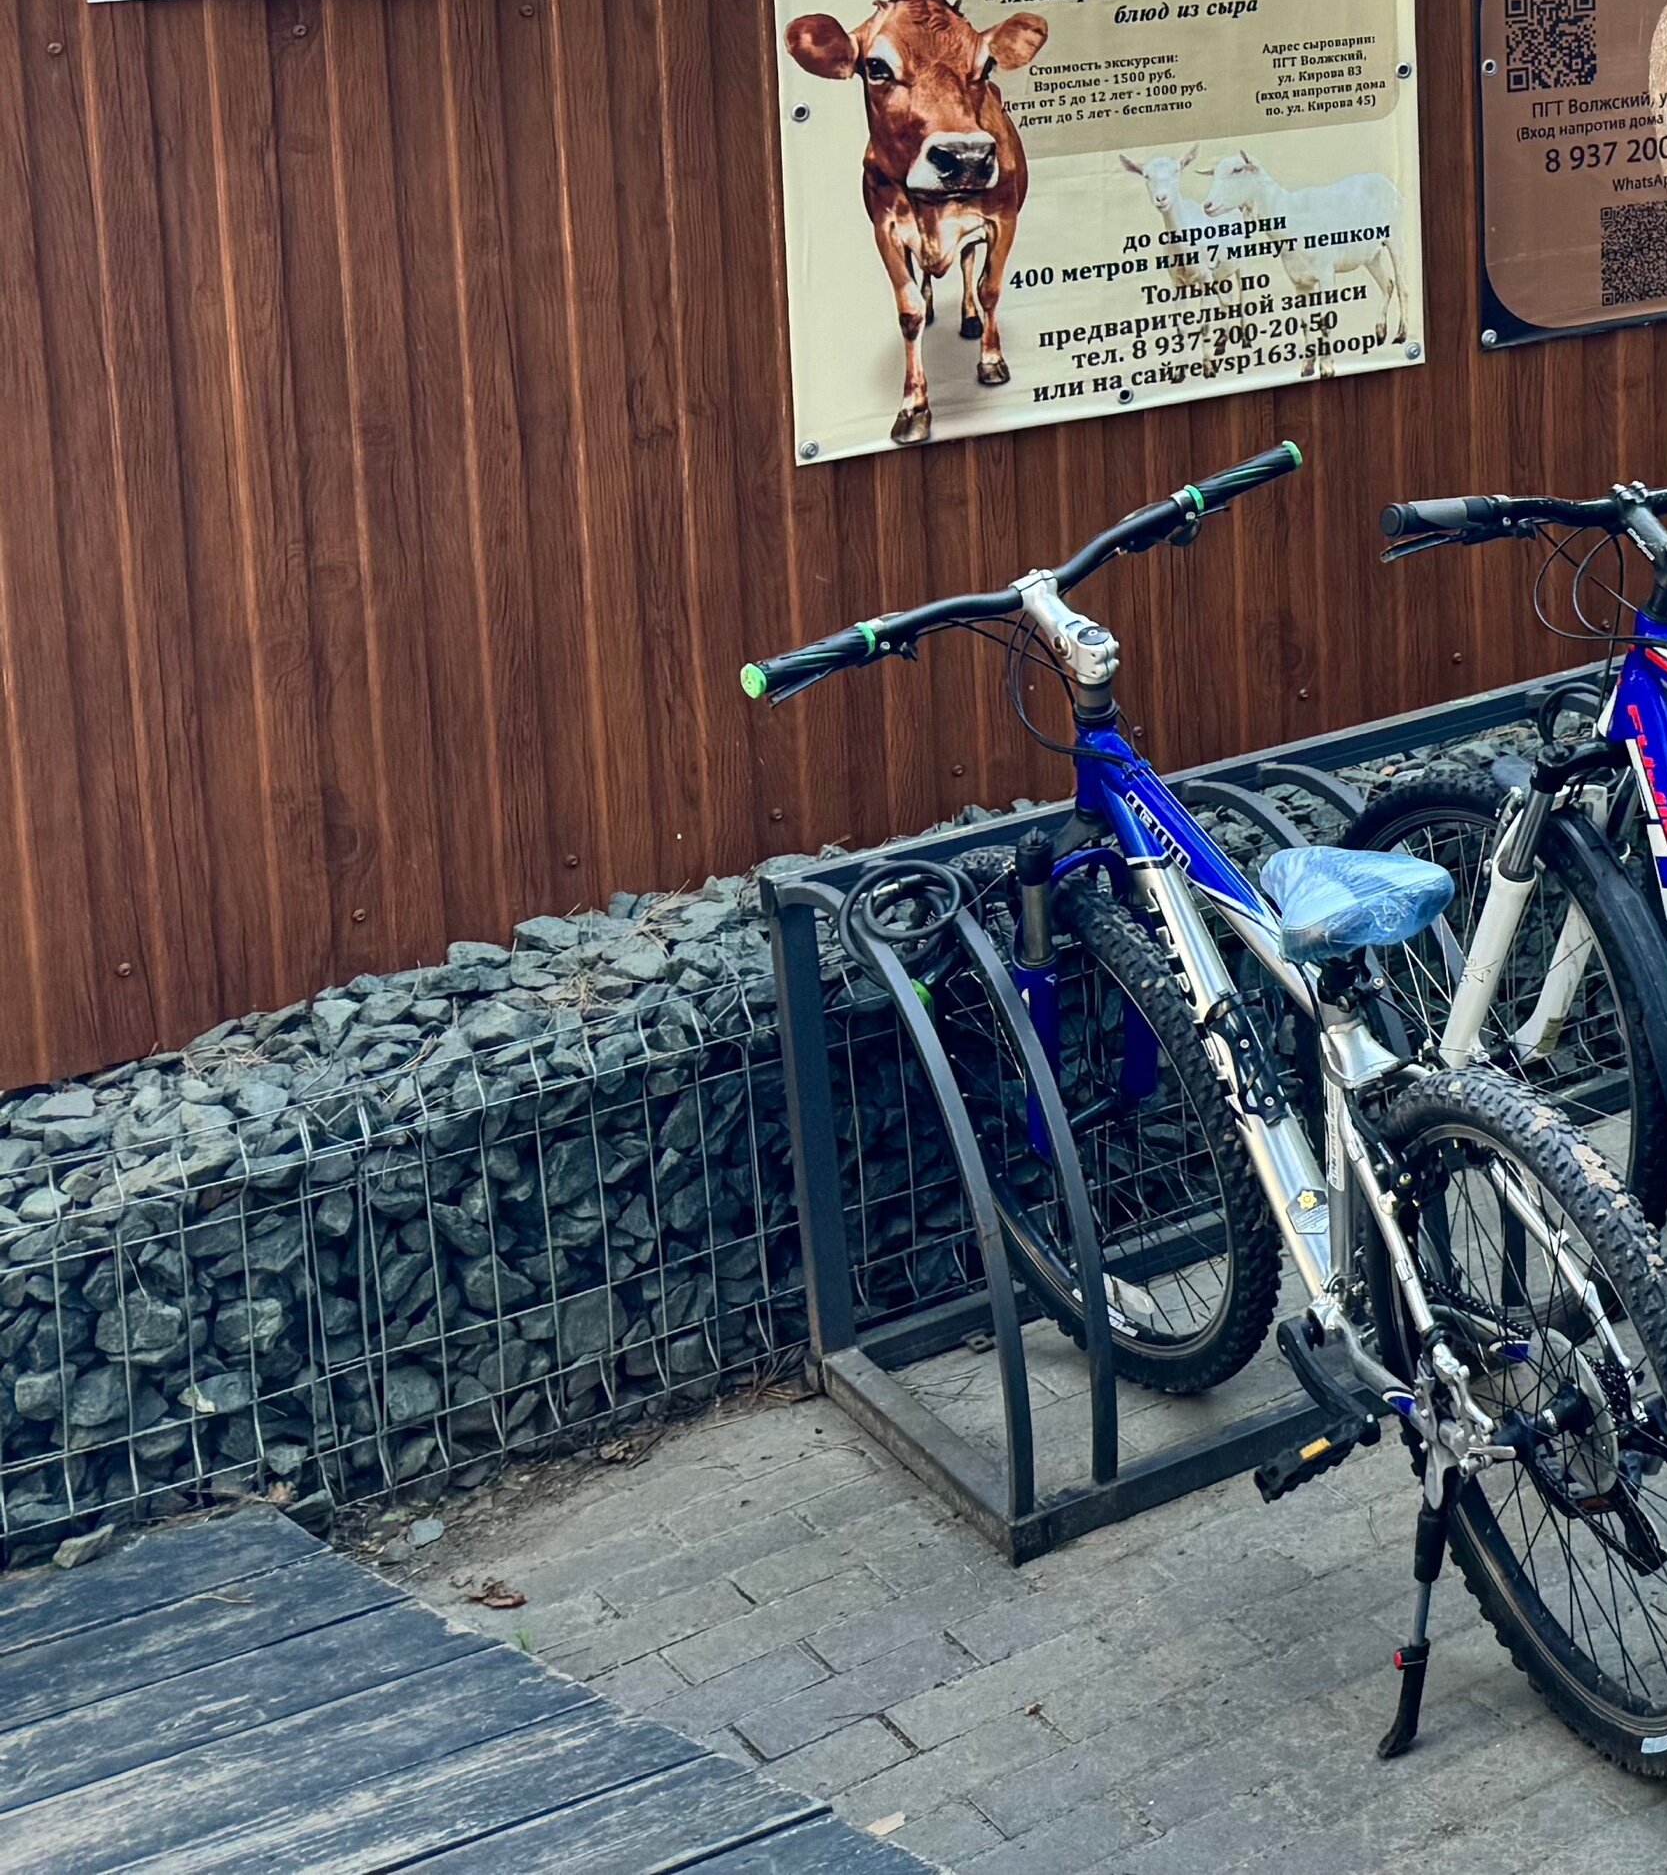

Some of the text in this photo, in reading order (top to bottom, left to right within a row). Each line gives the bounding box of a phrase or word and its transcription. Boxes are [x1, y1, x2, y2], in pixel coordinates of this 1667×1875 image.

[1114, 0, 1258, 24] блюд из сыра
[1263, 43, 1300, 55] Адрес
[1273, 57, 1297, 68] ПГТ
[1029, 54, 1178, 76] Стоимость экскурсии:
[1278, 75, 1295, 86] ул.
[1299, 69, 1344, 82] Кирова
[1034, 69, 1176, 94] Взрослые 1500 руб.
[1292, 84, 1352, 98] напротив
[1355, 80, 1386, 93] дома
[1308, 98, 1353, 112] Кирова
[1356, 95, 1376, 106] 45)
[1532, 100, 1565, 119] ПГТ
[1569, 91, 1656, 115] Волжский,
[1516, 125, 1556, 143] (Вход
[1559, 118, 1626, 137] напротив
[1629, 114, 1664, 130] дома
[1545, 147, 1562, 174] 8
[1569, 141, 1618, 171] 937
[1122, 215, 1287, 254] до сыроварни
[1009, 223, 1391, 289] 400 метров или 7 минут пешком
[1141, 273, 1271, 306] Только по
[1038, 283, 1368, 352] предварительной записи
[1072, 309, 1339, 370] тел. 8 937-200-20-50
[1033, 379, 1085, 403] или
[1092, 376, 1124, 393] на
[1130, 359, 1211, 387] сайте
